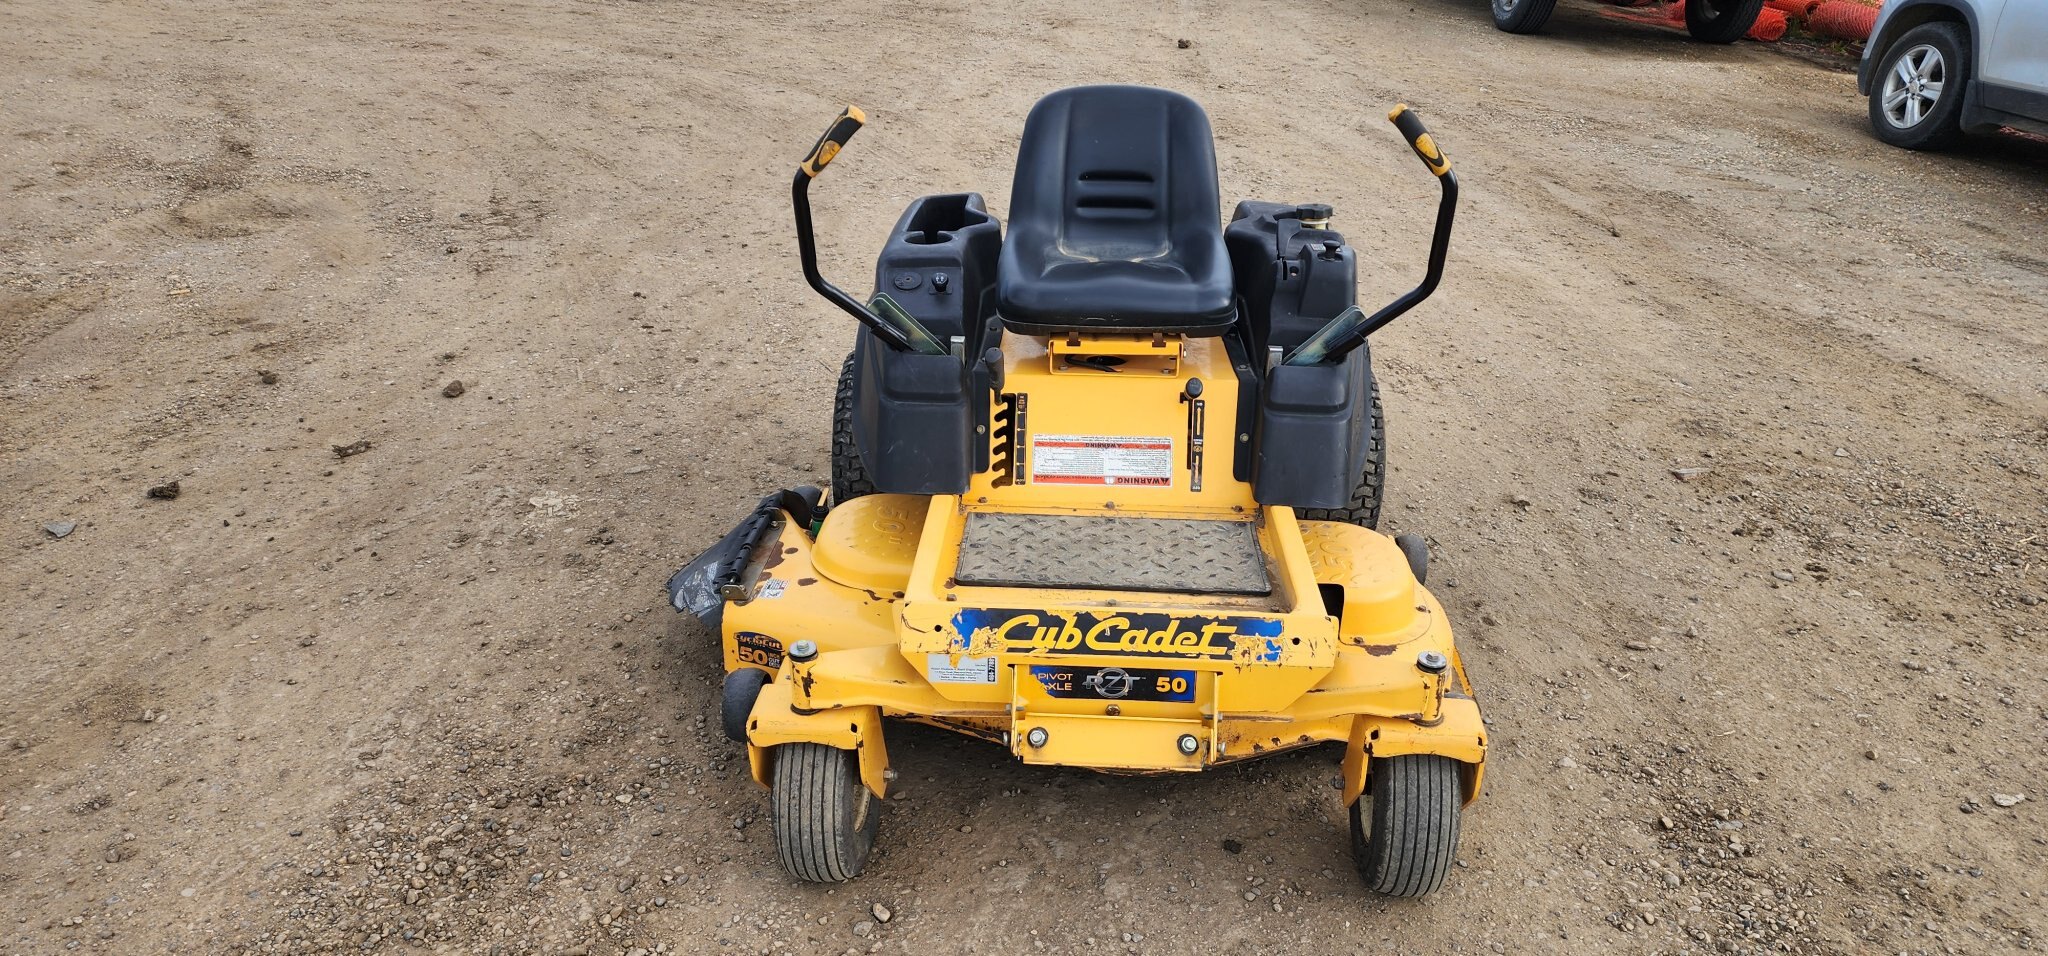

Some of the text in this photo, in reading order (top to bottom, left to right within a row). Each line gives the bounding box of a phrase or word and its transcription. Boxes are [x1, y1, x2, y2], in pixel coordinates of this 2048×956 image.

[1118, 477, 1160, 485] WARNING
[997, 614, 1237, 655] Cub Cadet
[740, 646, 767, 665] 50
[1038, 673, 1073, 681] PIVOT
[1082, 671, 1142, 692] RZT
[1156, 677, 1187, 693] 50
